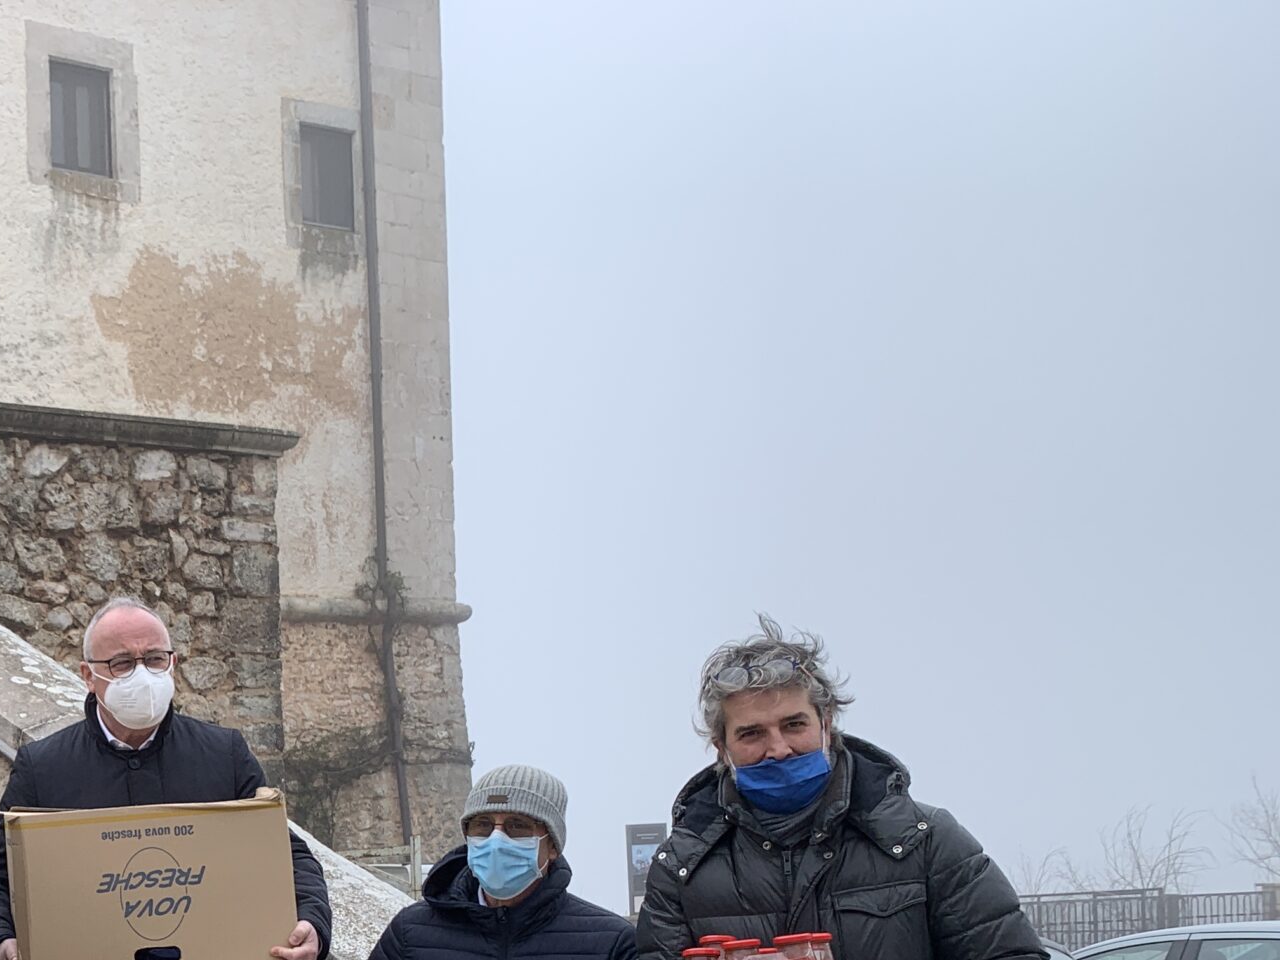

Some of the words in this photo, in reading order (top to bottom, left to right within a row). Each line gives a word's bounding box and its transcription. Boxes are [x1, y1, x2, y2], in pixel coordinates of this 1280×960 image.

[101, 829, 142, 841] fresche
[145, 826, 170, 836] uova
[174, 825, 194, 836] 200
[96, 865, 206, 894] FRESCHE
[124, 895, 192, 918] UOVA
